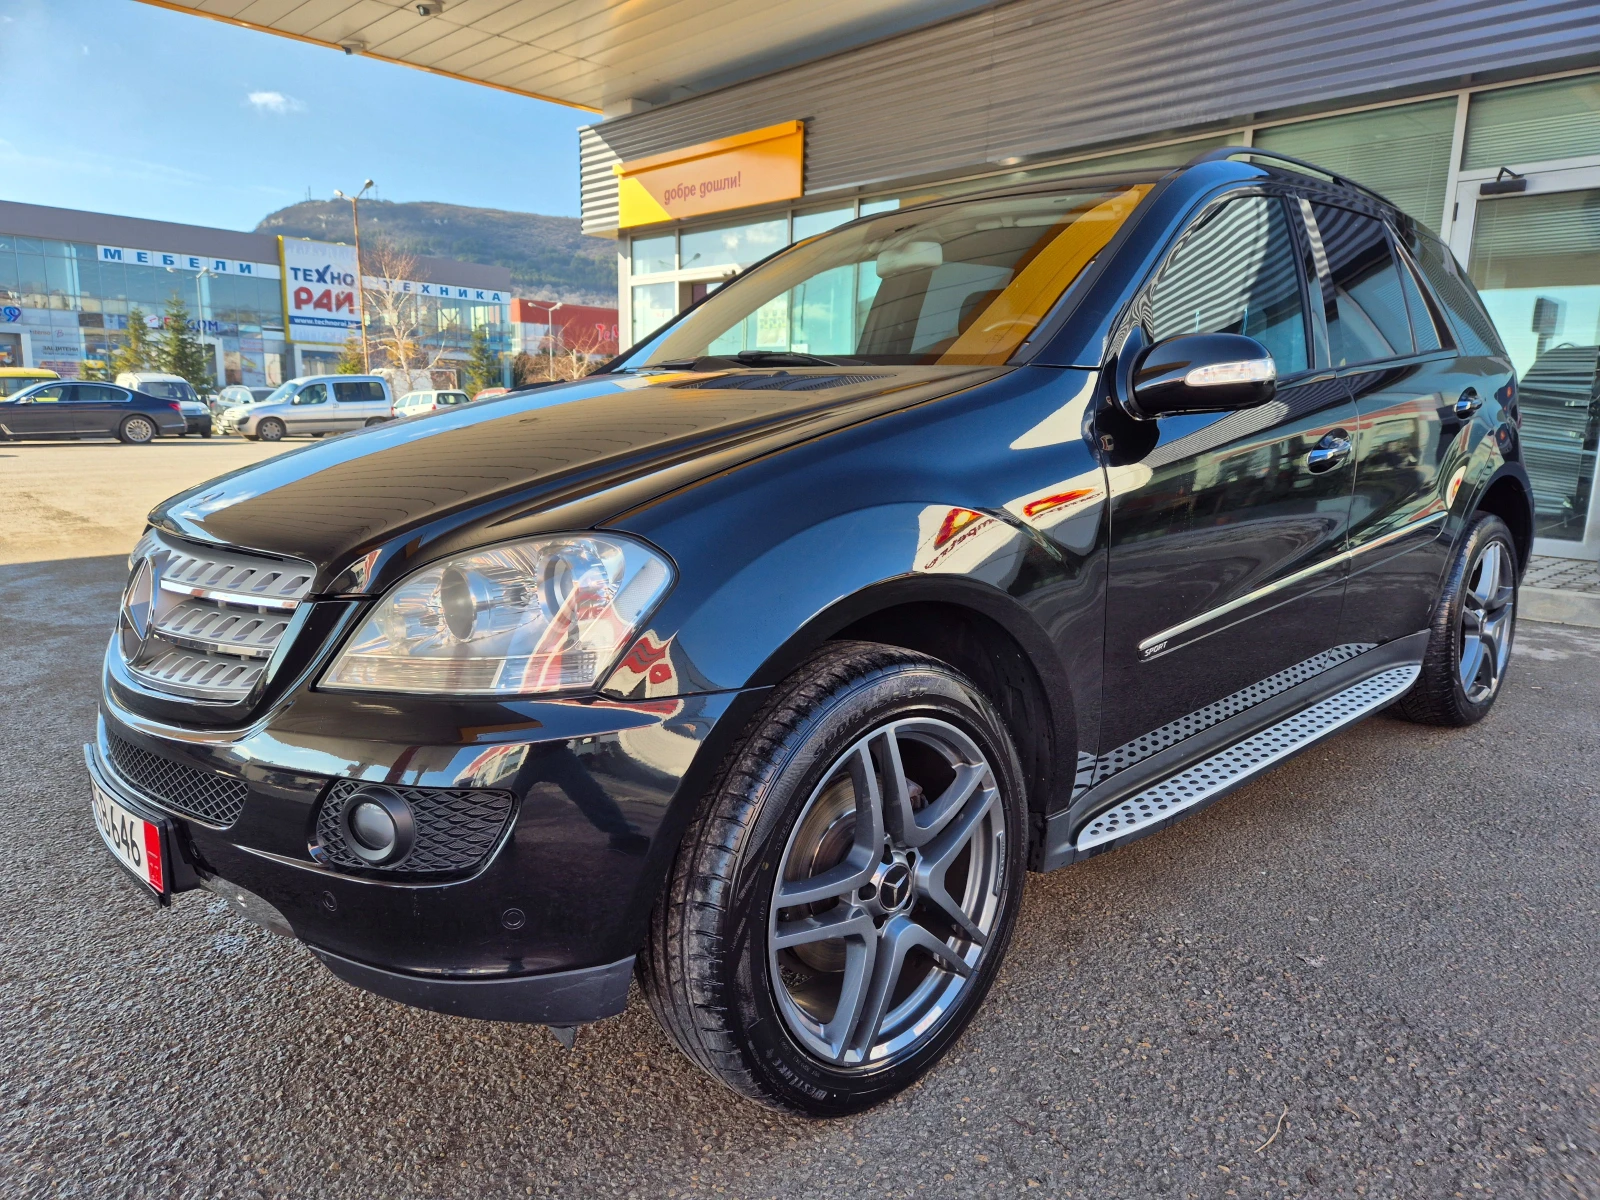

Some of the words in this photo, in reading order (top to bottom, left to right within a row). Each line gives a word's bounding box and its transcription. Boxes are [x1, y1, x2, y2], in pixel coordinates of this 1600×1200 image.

[664, 182, 697, 205] добре
[699, 171, 741, 198] дошли!
[103, 248, 252, 274] МЕБЕЛИ
[290, 264, 355, 287] ТЕХНО
[294, 286, 355, 315] РАЙ
[382, 279, 501, 302] ТЕХНИКА
[1144, 640, 1168, 657] SPORT
